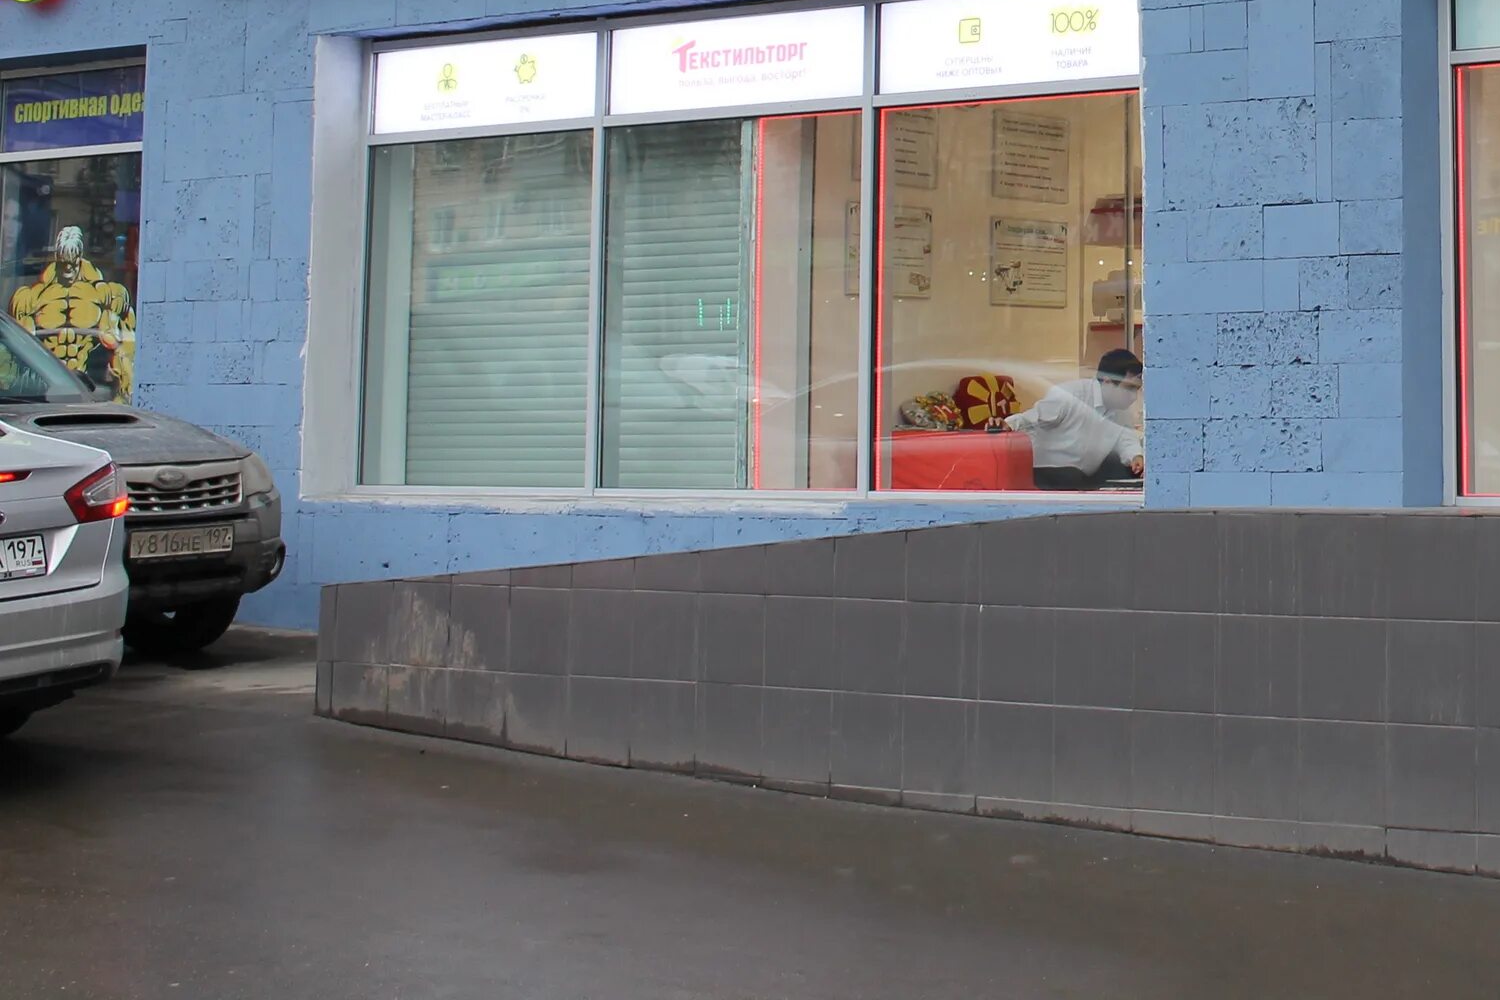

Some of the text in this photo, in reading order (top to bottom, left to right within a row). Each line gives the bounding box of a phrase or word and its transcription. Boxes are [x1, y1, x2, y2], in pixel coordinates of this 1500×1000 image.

[1051, 9, 1099, 34] 100%
[205, 528, 229, 545] 197
[7, 538, 36, 560] 197
[15, 560, 32, 568] RUS
